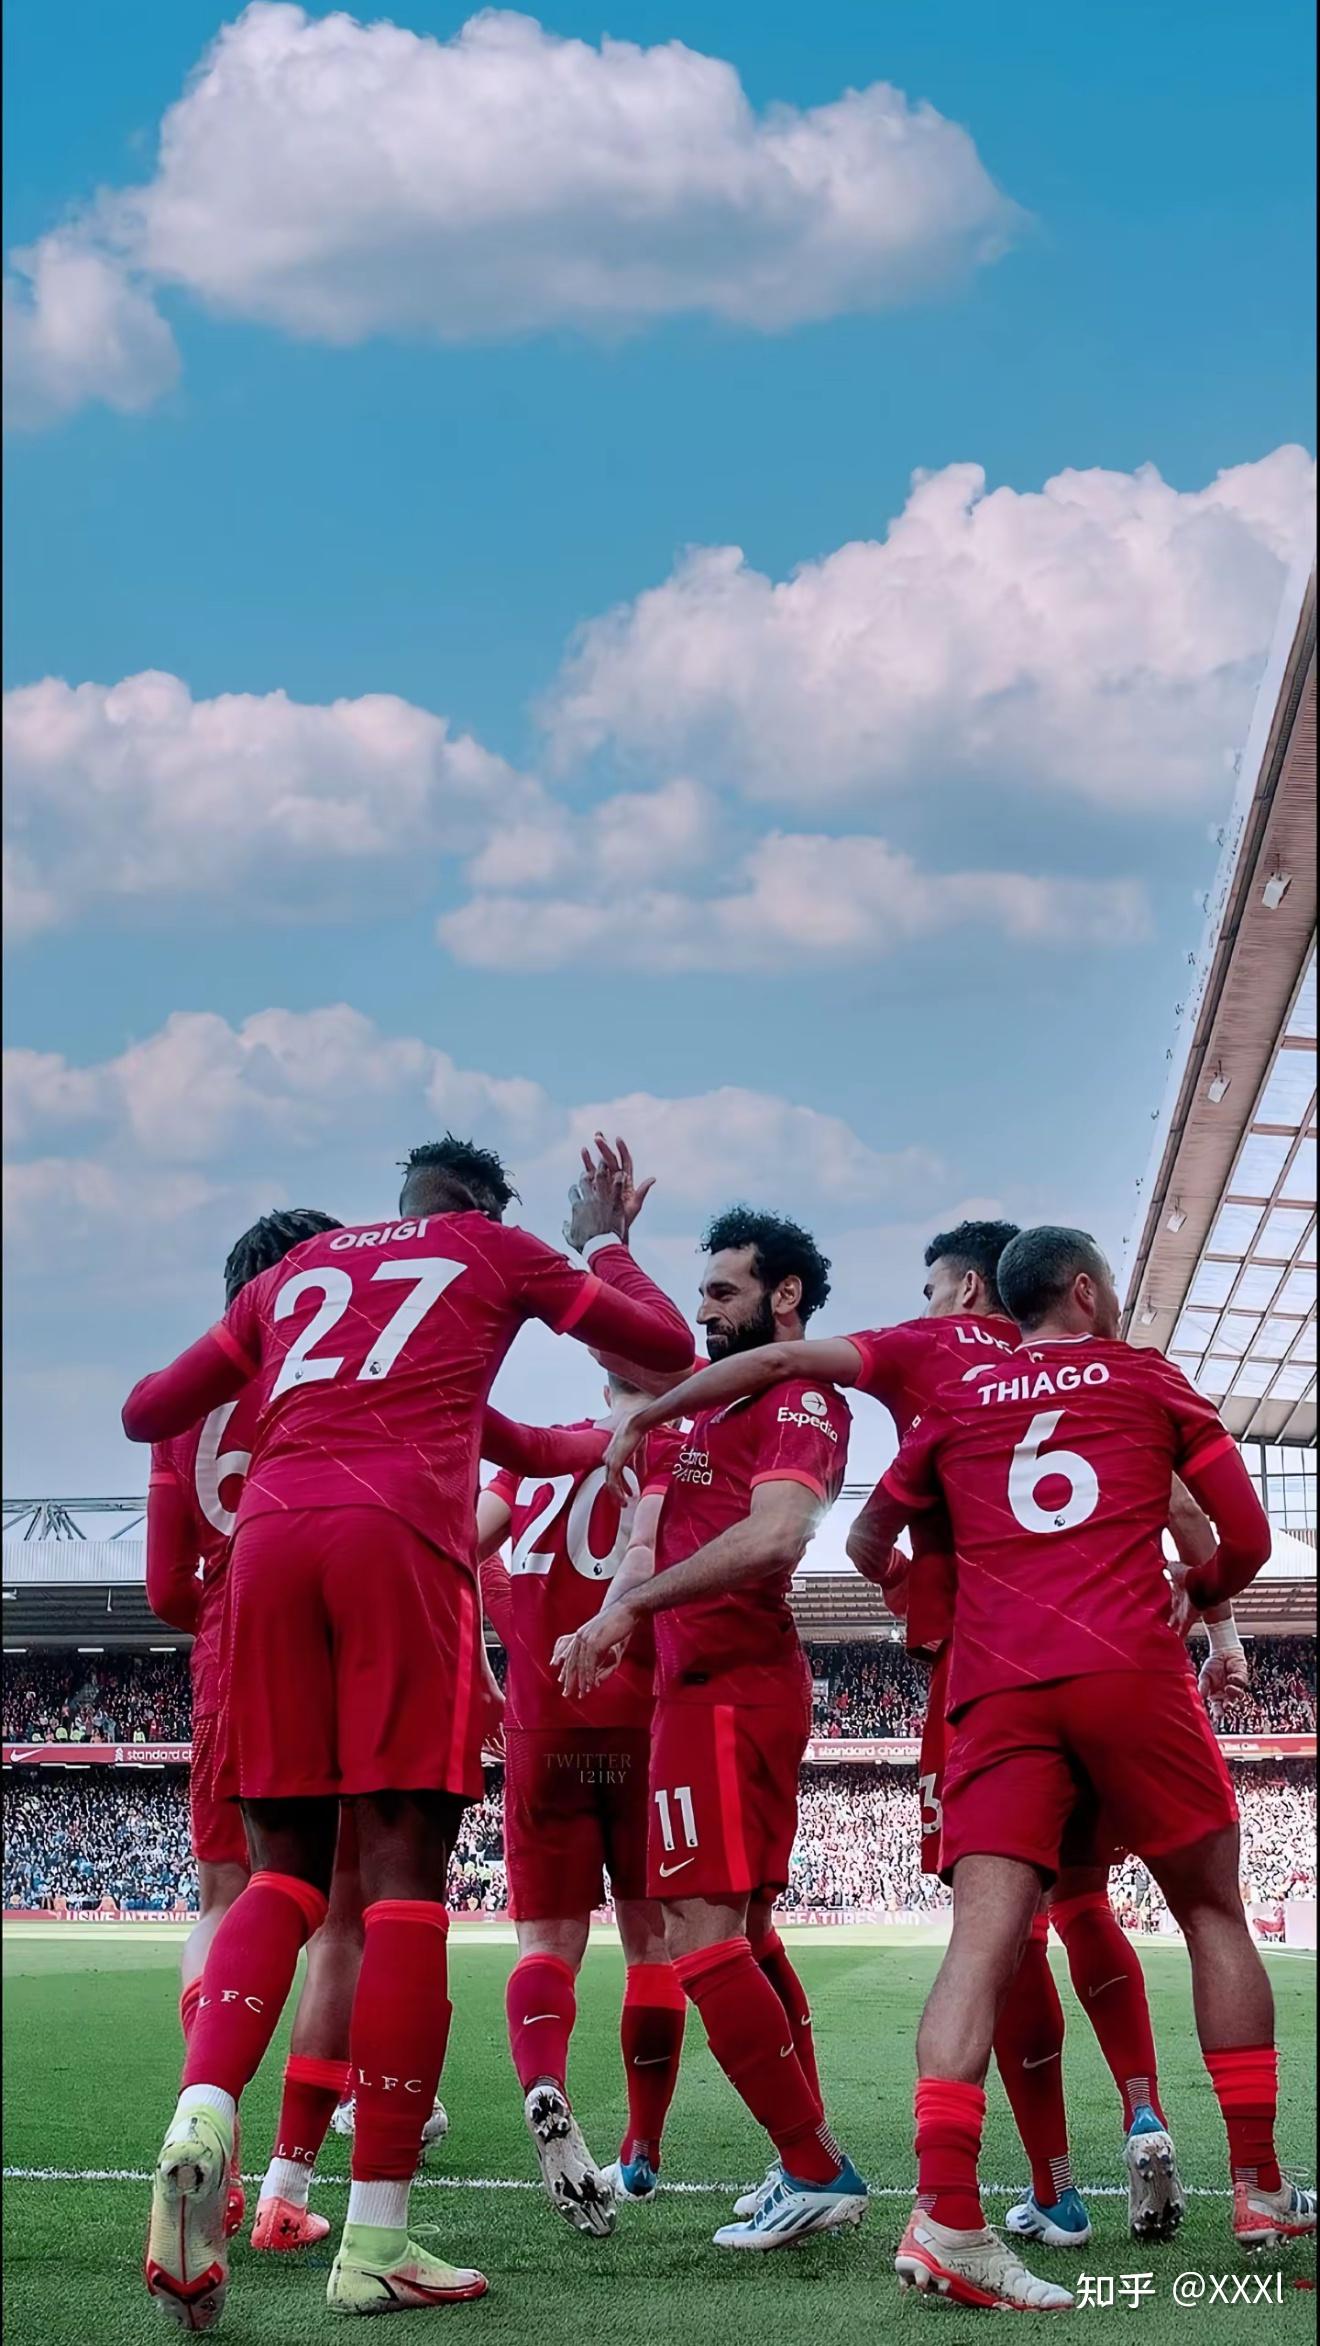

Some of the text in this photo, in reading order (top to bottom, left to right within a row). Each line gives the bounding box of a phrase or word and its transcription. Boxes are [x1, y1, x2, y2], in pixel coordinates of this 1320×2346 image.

[329, 1219, 429, 1251] ORIGI
[270, 1257, 468, 1404] 27
[977, 1362, 1110, 1405] THIAGO
[777, 1407, 838, 1443] Expedia
[1008, 1409, 1099, 1533] 6
[510, 1464, 641, 1581] 20
[127, 1749, 180, 1761] standard
[818, 1744, 875, 1756] standard
[655, 1786, 698, 1851] 11
[358, 2068, 422, 2093] LFC
[278, 2143, 315, 2162] LFC
